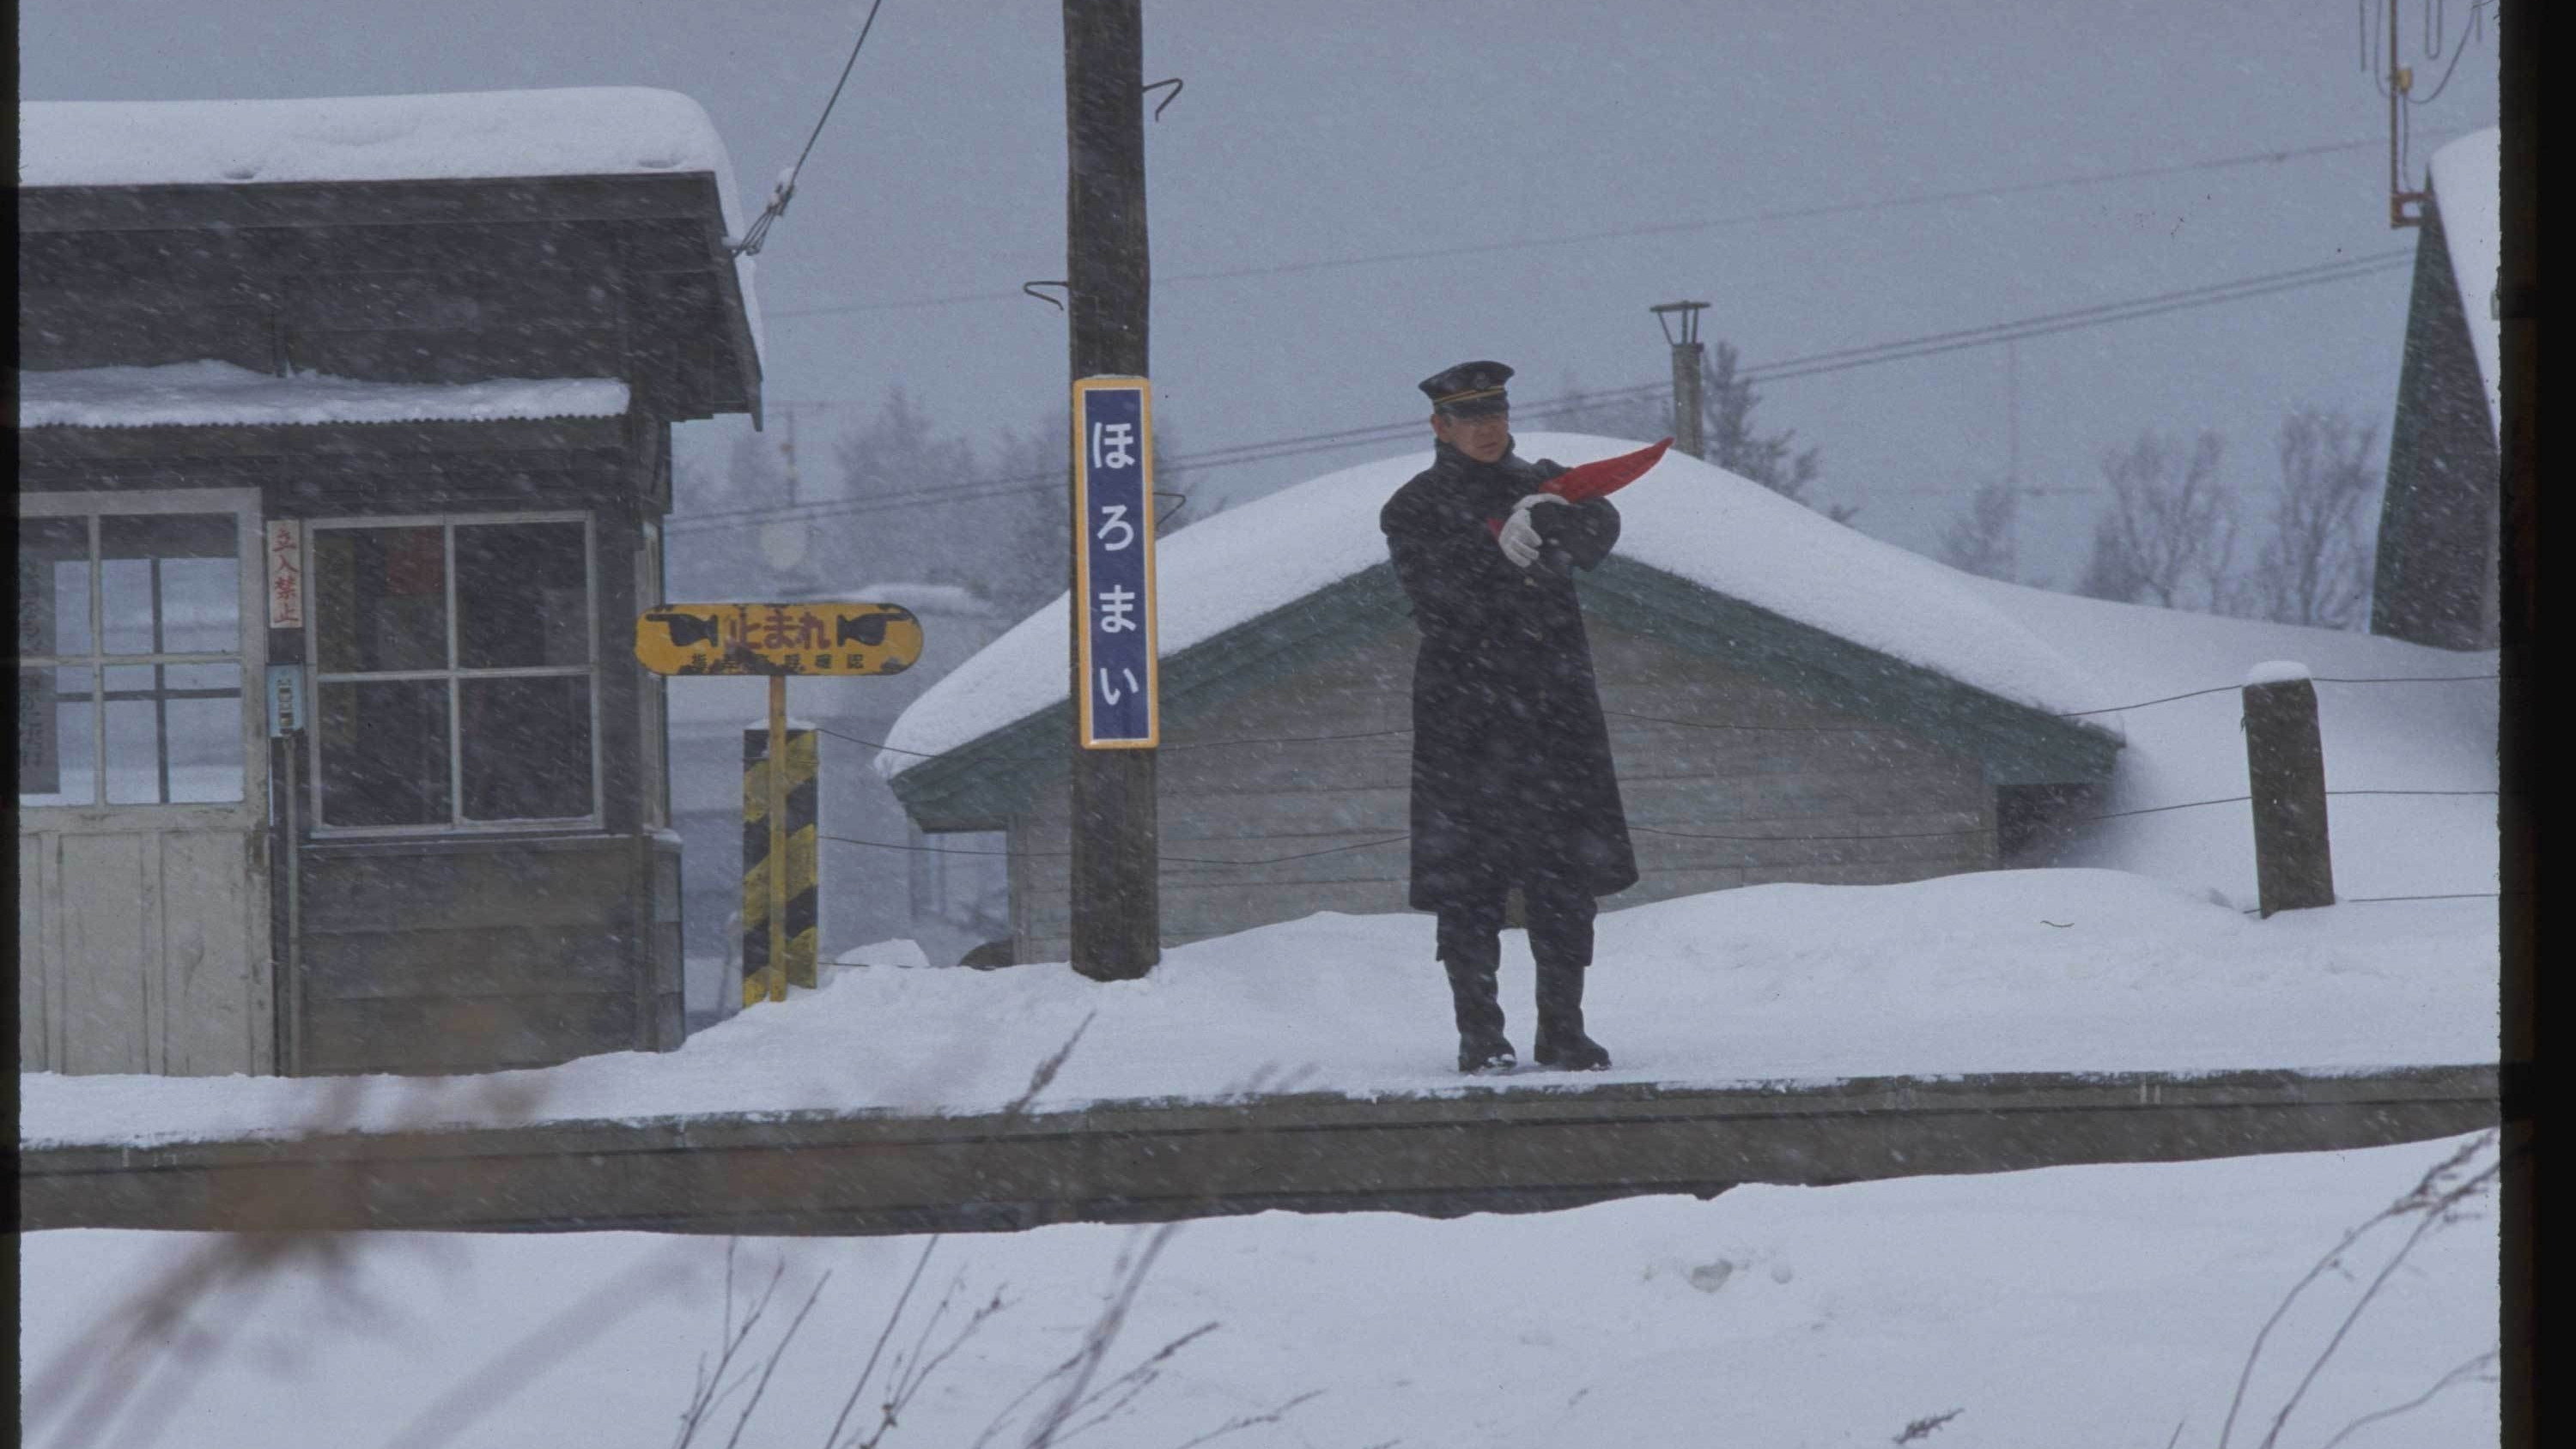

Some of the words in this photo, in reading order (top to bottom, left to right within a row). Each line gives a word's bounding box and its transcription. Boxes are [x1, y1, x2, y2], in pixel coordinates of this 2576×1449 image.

[272, 527, 299, 624] 立入禁止
[1092, 421, 1139, 706] ほろまい
[725, 606, 832, 650] 止まれ
